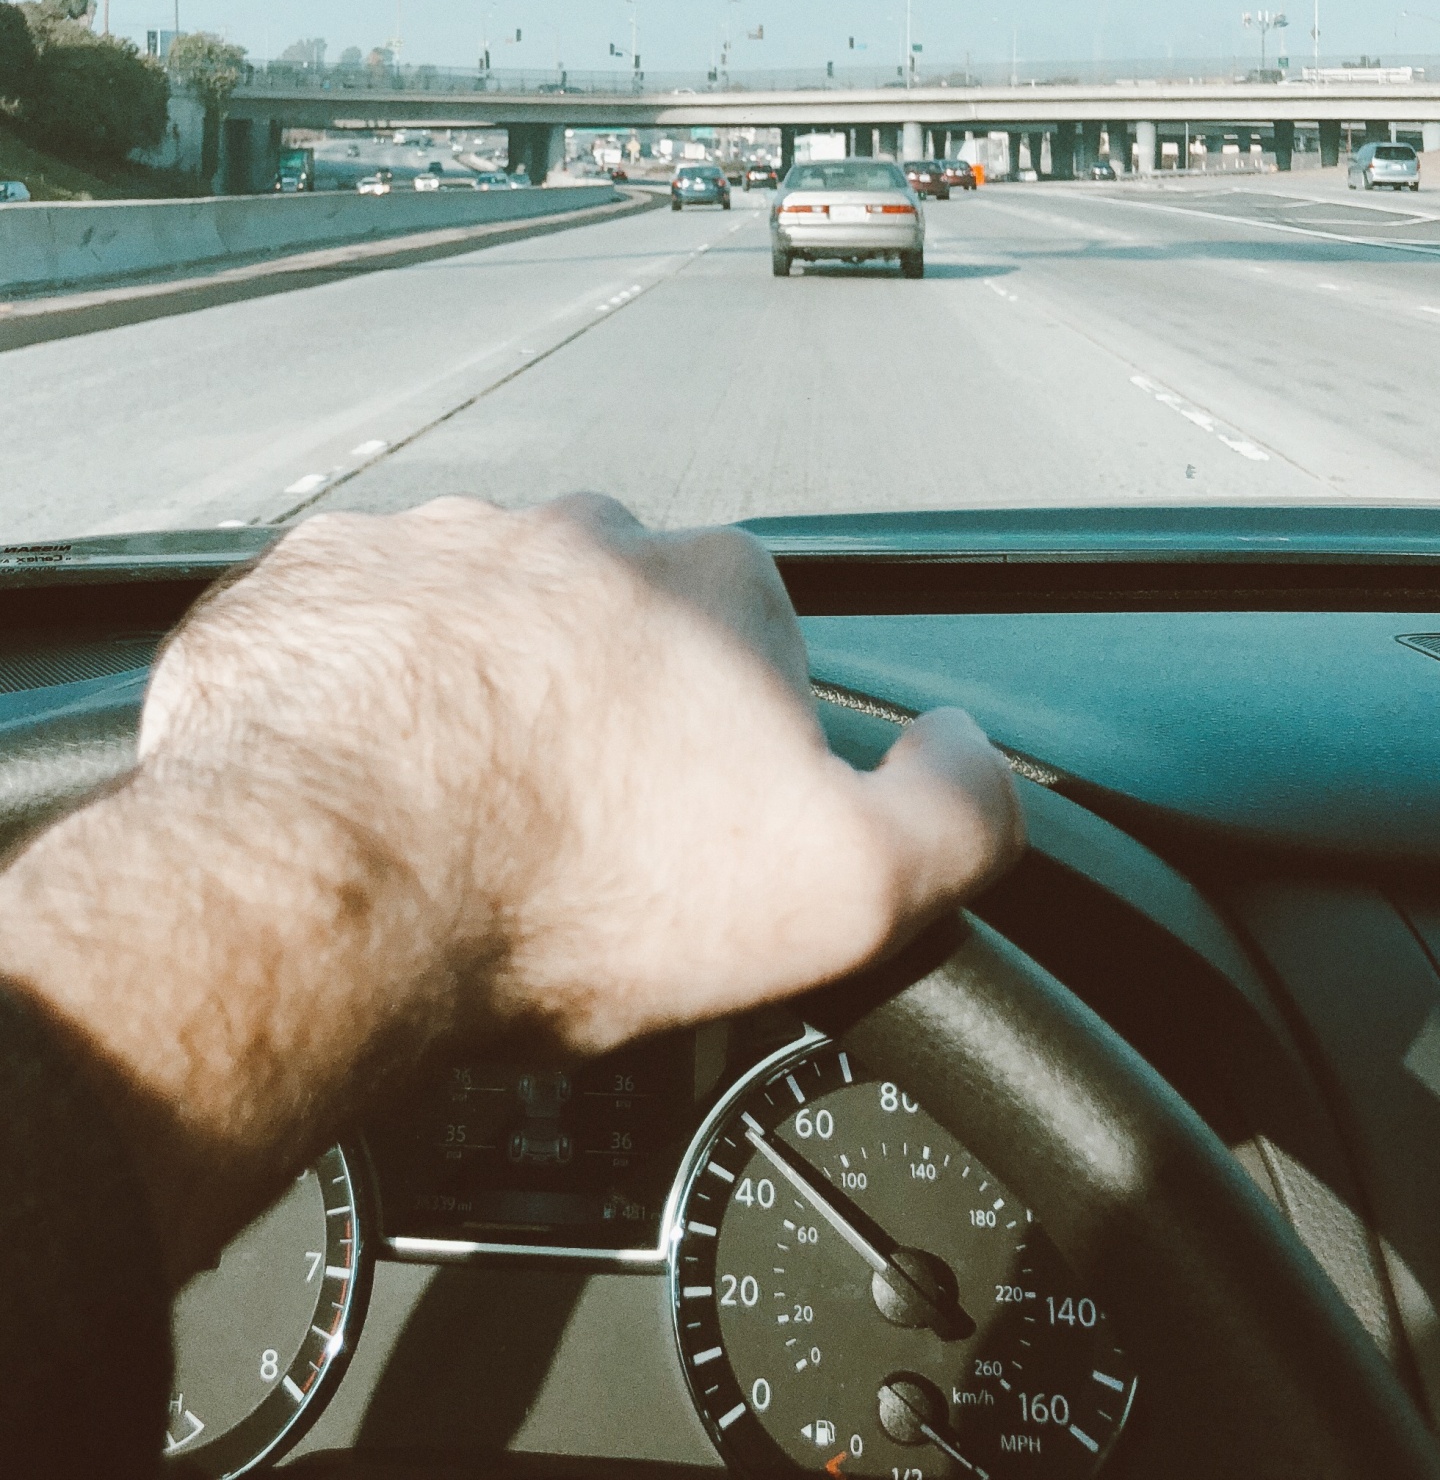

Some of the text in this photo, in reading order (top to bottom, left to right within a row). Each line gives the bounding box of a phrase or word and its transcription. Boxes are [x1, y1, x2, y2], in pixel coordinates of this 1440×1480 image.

[613, 1074, 635, 1093] 36
[795, 1108, 835, 1139] 60
[445, 1124, 467, 1143] 35
[611, 1131, 633, 1150] 36
[841, 1172, 868, 1190] 100
[910, 1163, 937, 1180] 140
[735, 1177, 776, 1208] 40
[969, 1209, 997, 1227] 180
[797, 1226, 819, 1244] 60
[305, 1251, 322, 1283] 7
[720, 1274, 759, 1307] 20
[995, 1284, 1024, 1303] 220
[793, 1304, 814, 1323] 20
[1046, 1297, 1097, 1327] 140
[260, 1348, 278, 1380] 8
[810, 1347, 822, 1365] 0
[974, 1359, 1003, 1377] 260
[752, 1378, 771, 1411] 0
[952, 1386, 995, 1406] km/h
[1018, 1392, 1070, 1426] 160
[850, 1434, 863, 1458] 0
[1000, 1434, 1042, 1454] MPH
